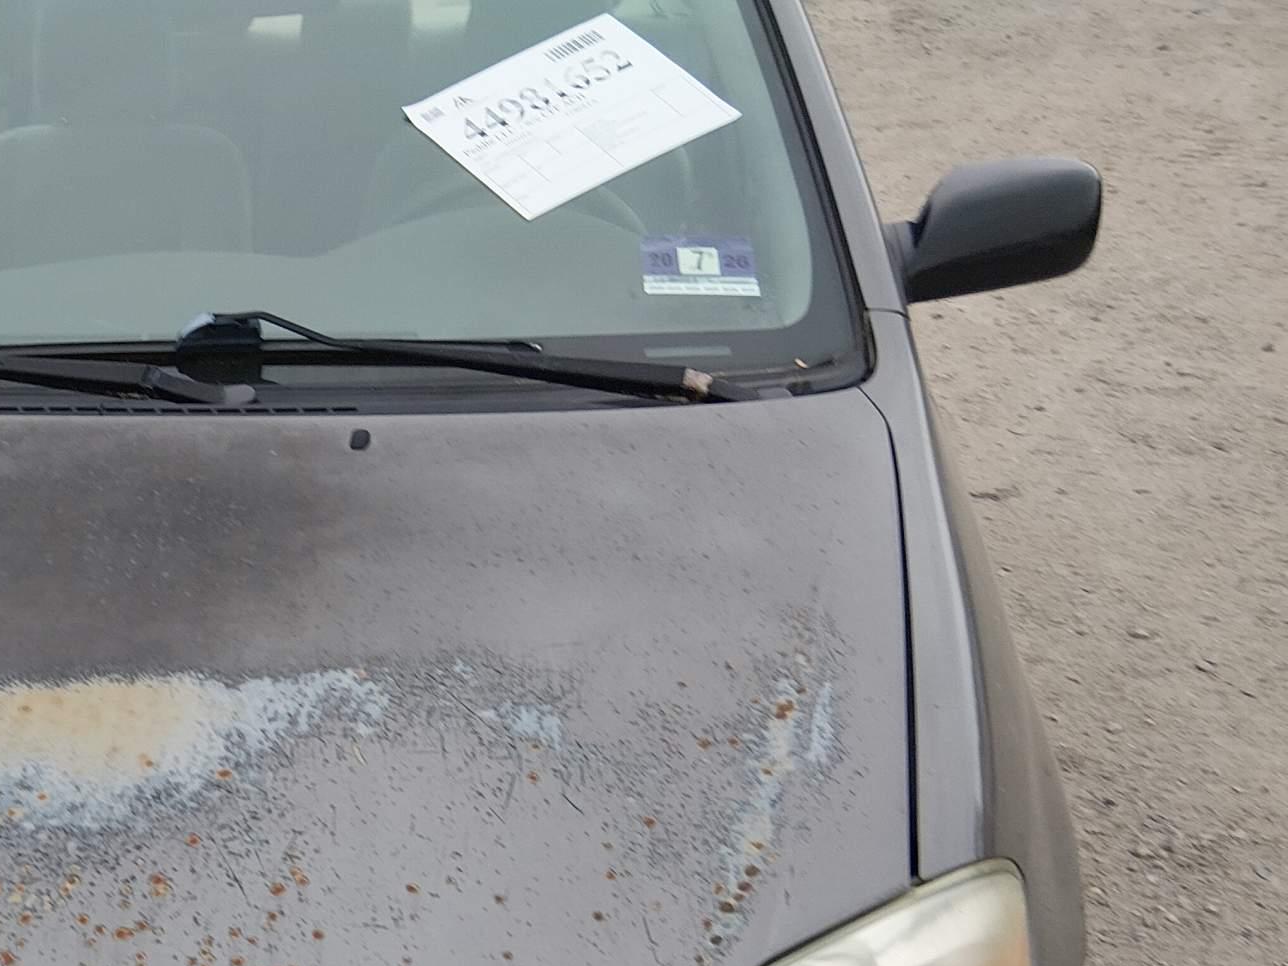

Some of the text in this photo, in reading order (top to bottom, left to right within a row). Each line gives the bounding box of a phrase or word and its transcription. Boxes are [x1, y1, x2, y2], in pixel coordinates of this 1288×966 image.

[464, 50, 633, 141] 44981652
[648, 251, 674, 268] 20
[690, 249, 704, 271] 7
